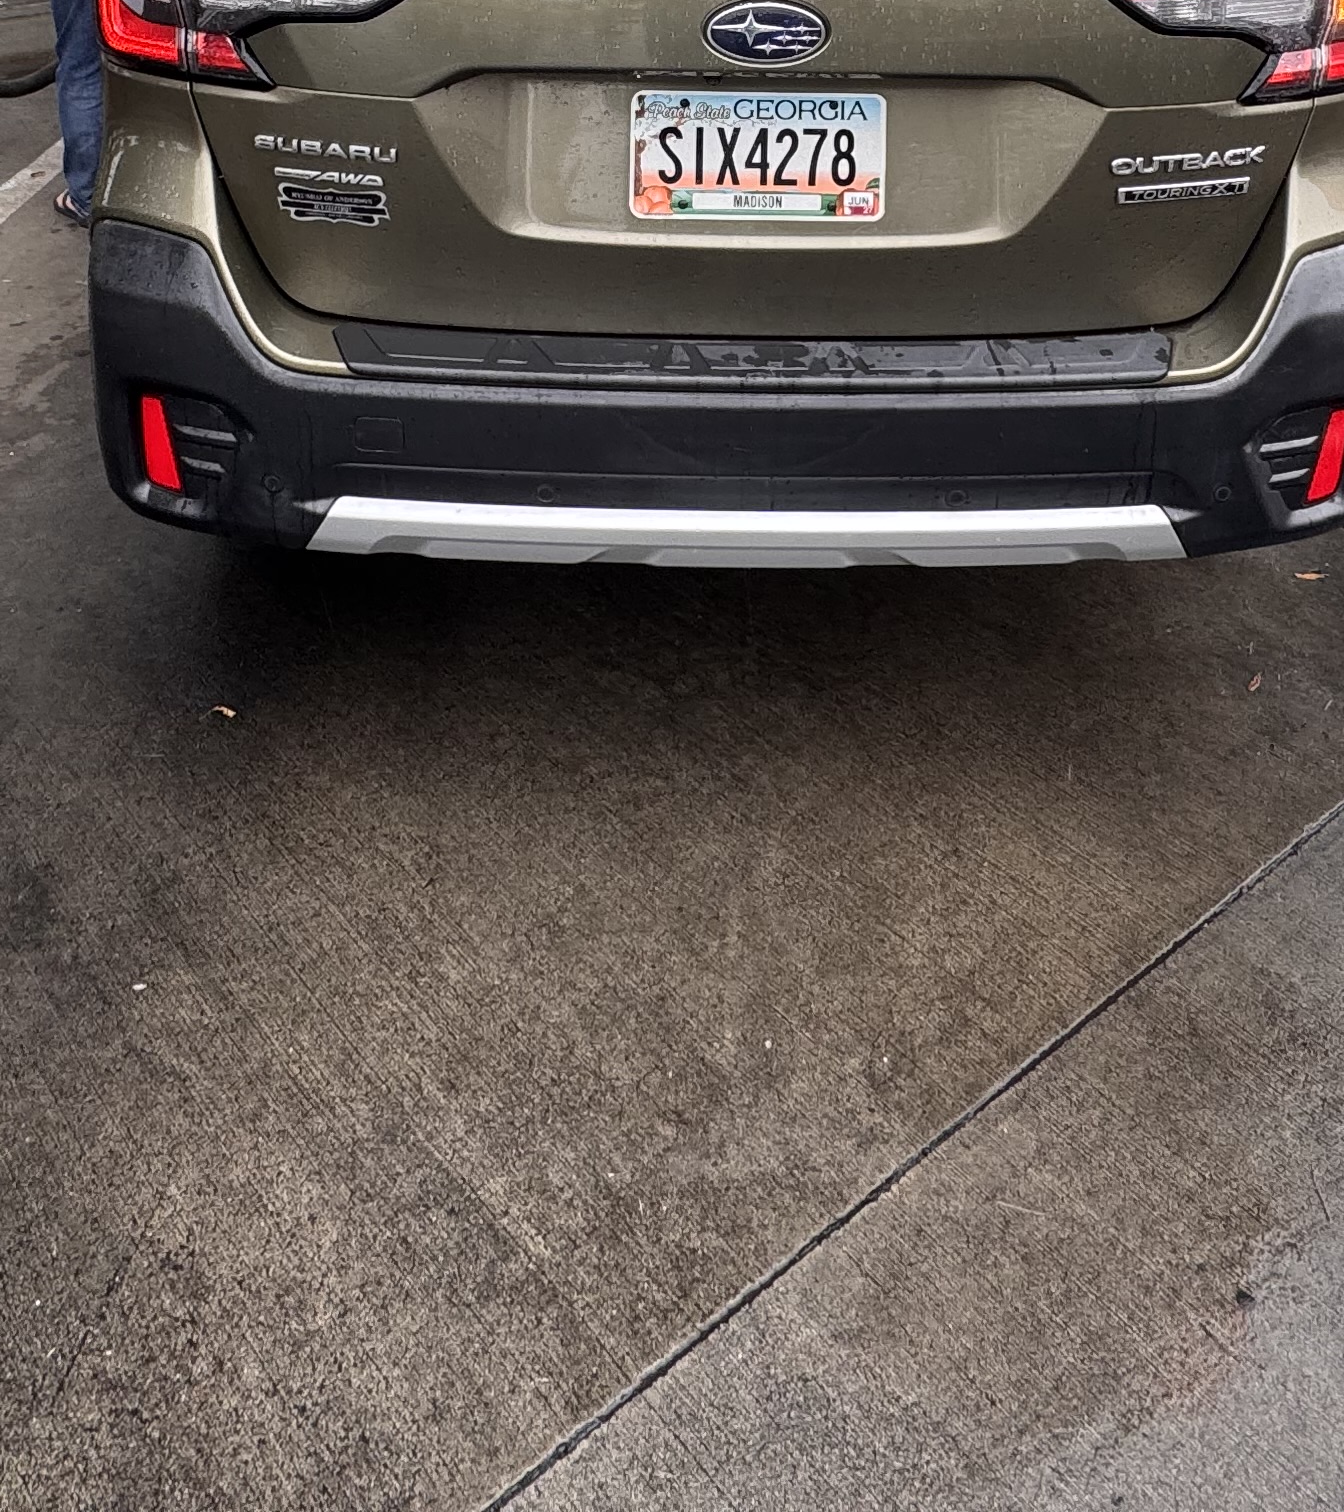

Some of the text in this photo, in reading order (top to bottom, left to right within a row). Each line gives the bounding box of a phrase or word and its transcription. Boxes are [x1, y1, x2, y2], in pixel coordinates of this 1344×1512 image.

[647, 100, 731, 120] Peach State
[733, 98, 868, 121] GEORGIA
[254, 134, 397, 164] SUBARU
[657, 126, 857, 187] SIX4278
[1110, 145, 1266, 175] OUTBACK
[313, 171, 385, 187] AWD
[732, 194, 783, 209] MADISON
[847, 196, 869, 206] JUN
[1132, 185, 1212, 201] TOURING
